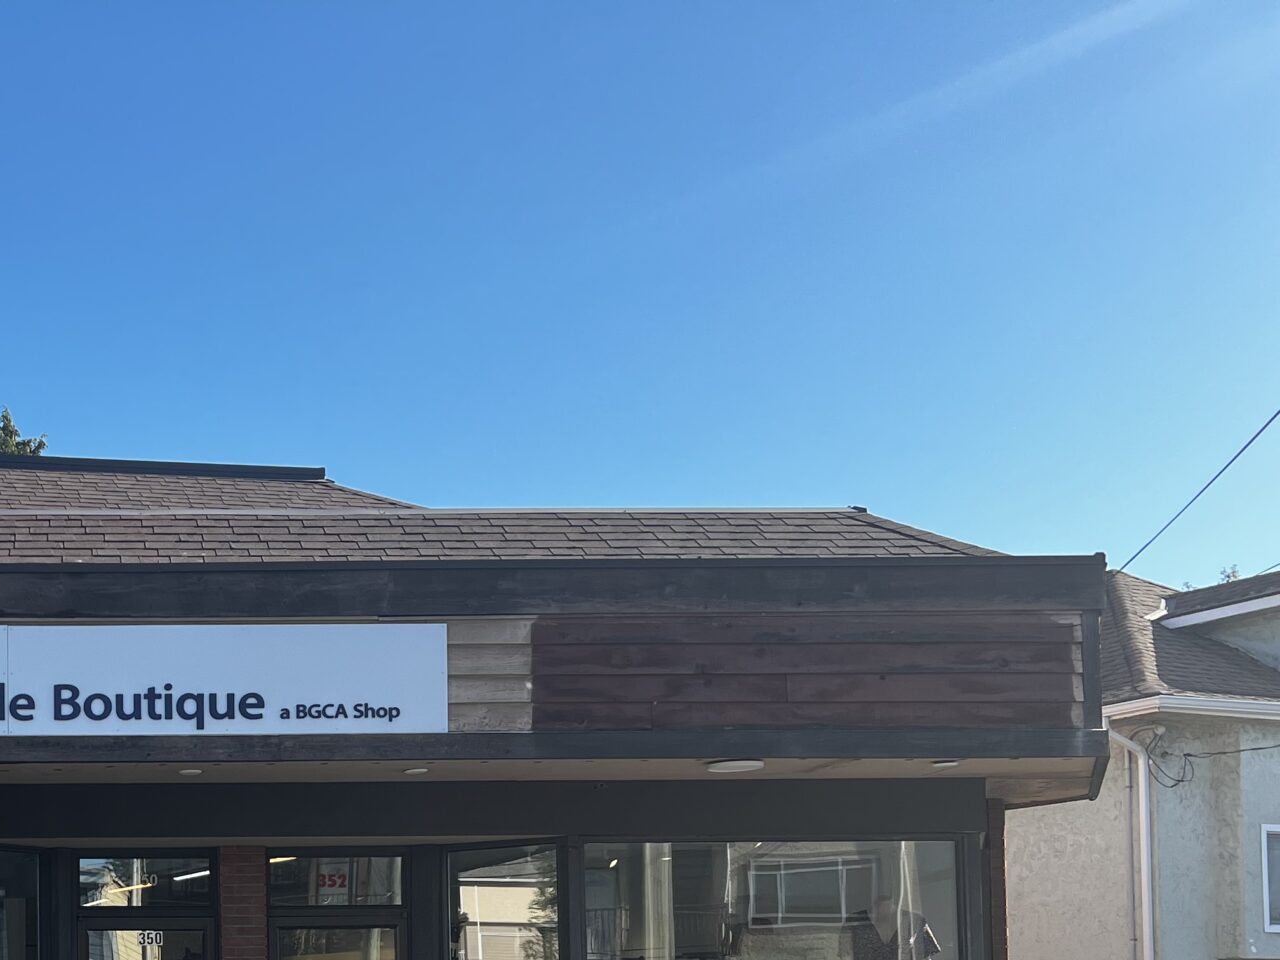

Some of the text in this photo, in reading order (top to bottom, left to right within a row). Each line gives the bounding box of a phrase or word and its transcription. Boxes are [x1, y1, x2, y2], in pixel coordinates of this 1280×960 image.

[53, 683, 265, 730] Boutique
[279, 708, 291, 719] a
[295, 704, 348, 719] BGCA
[353, 703, 401, 722] Shop
[319, 873, 347, 888] 352
[138, 931, 162, 945] 350
